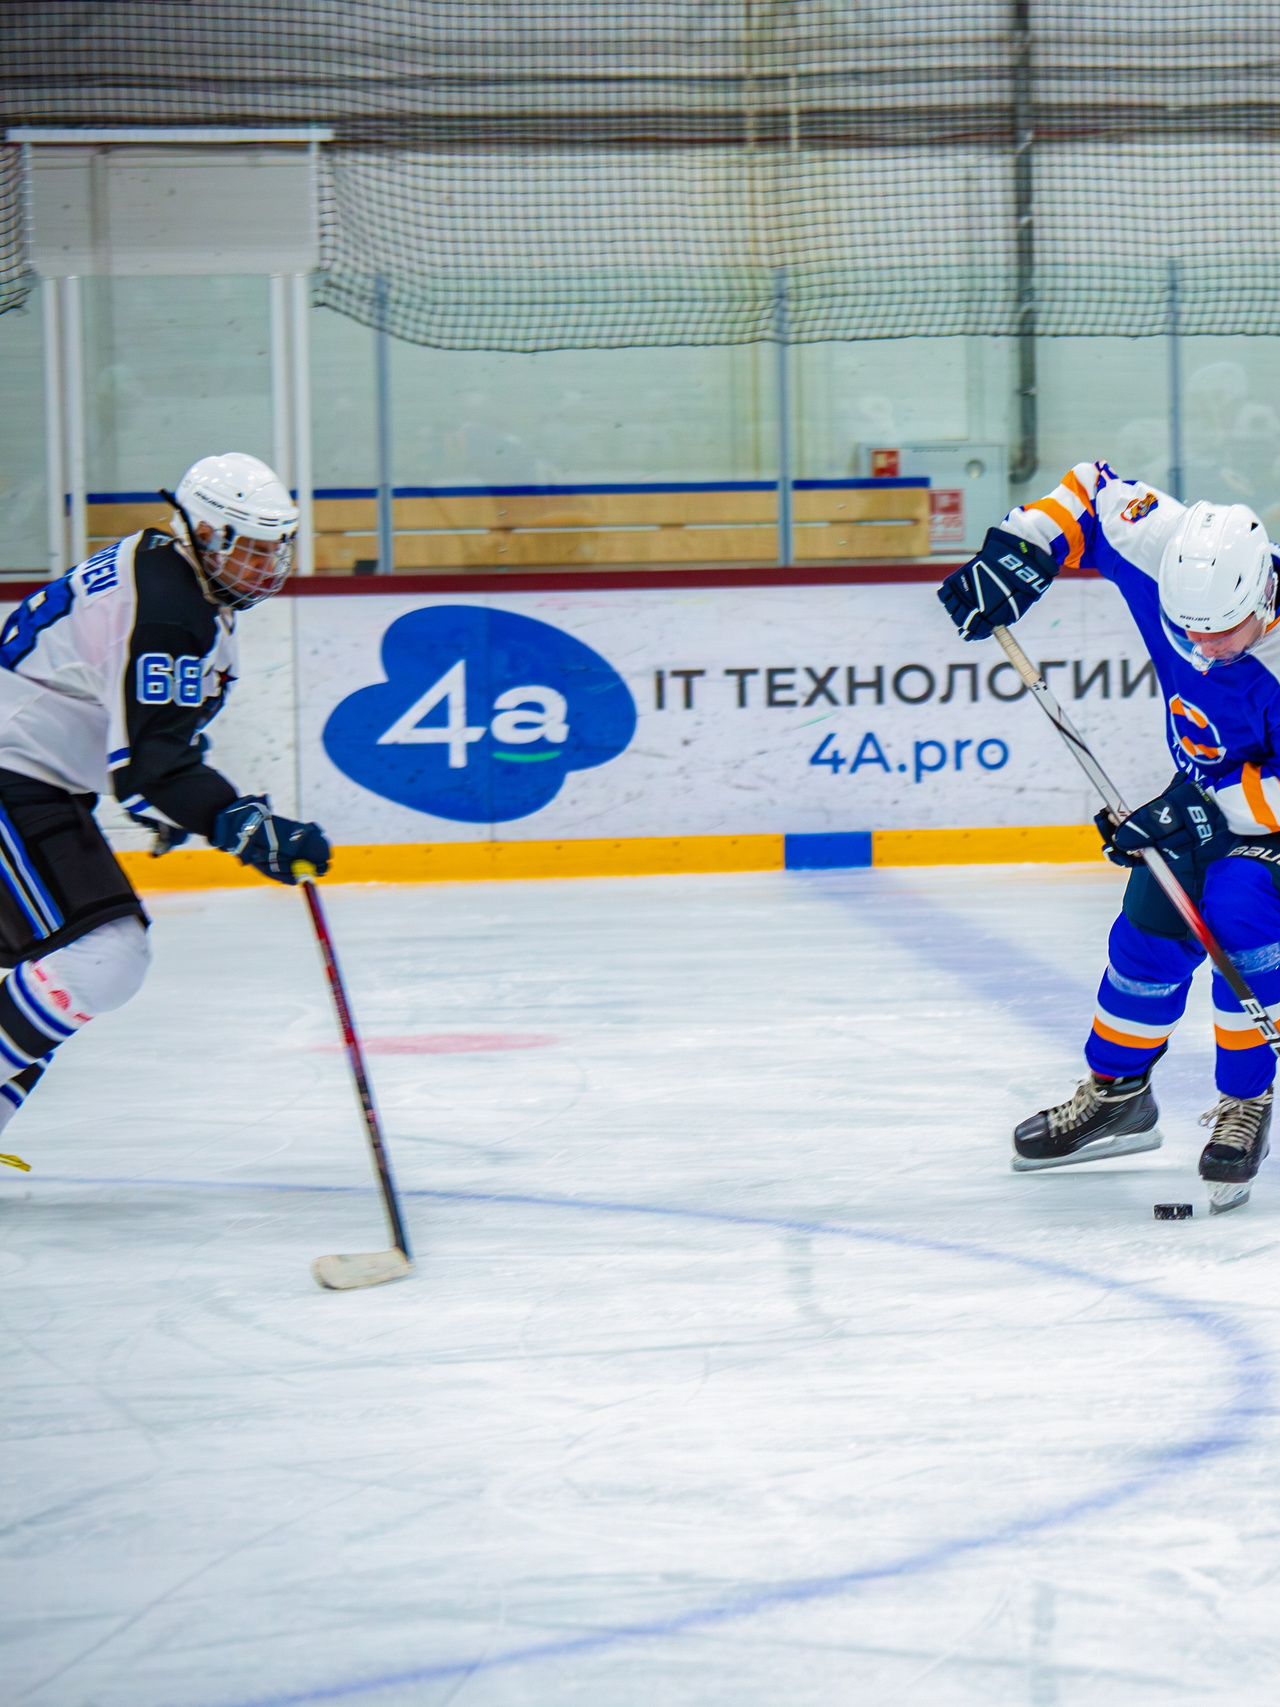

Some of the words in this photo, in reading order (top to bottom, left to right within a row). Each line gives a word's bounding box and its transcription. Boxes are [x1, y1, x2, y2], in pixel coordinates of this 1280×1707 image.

[136, 653, 203, 708] 68
[654, 668, 706, 710] IT
[724, 659, 1159, 706] ТЕХНОЛОГИИ
[376, 659, 569, 769] 4a
[809, 732, 1009, 784] 4A.pro
